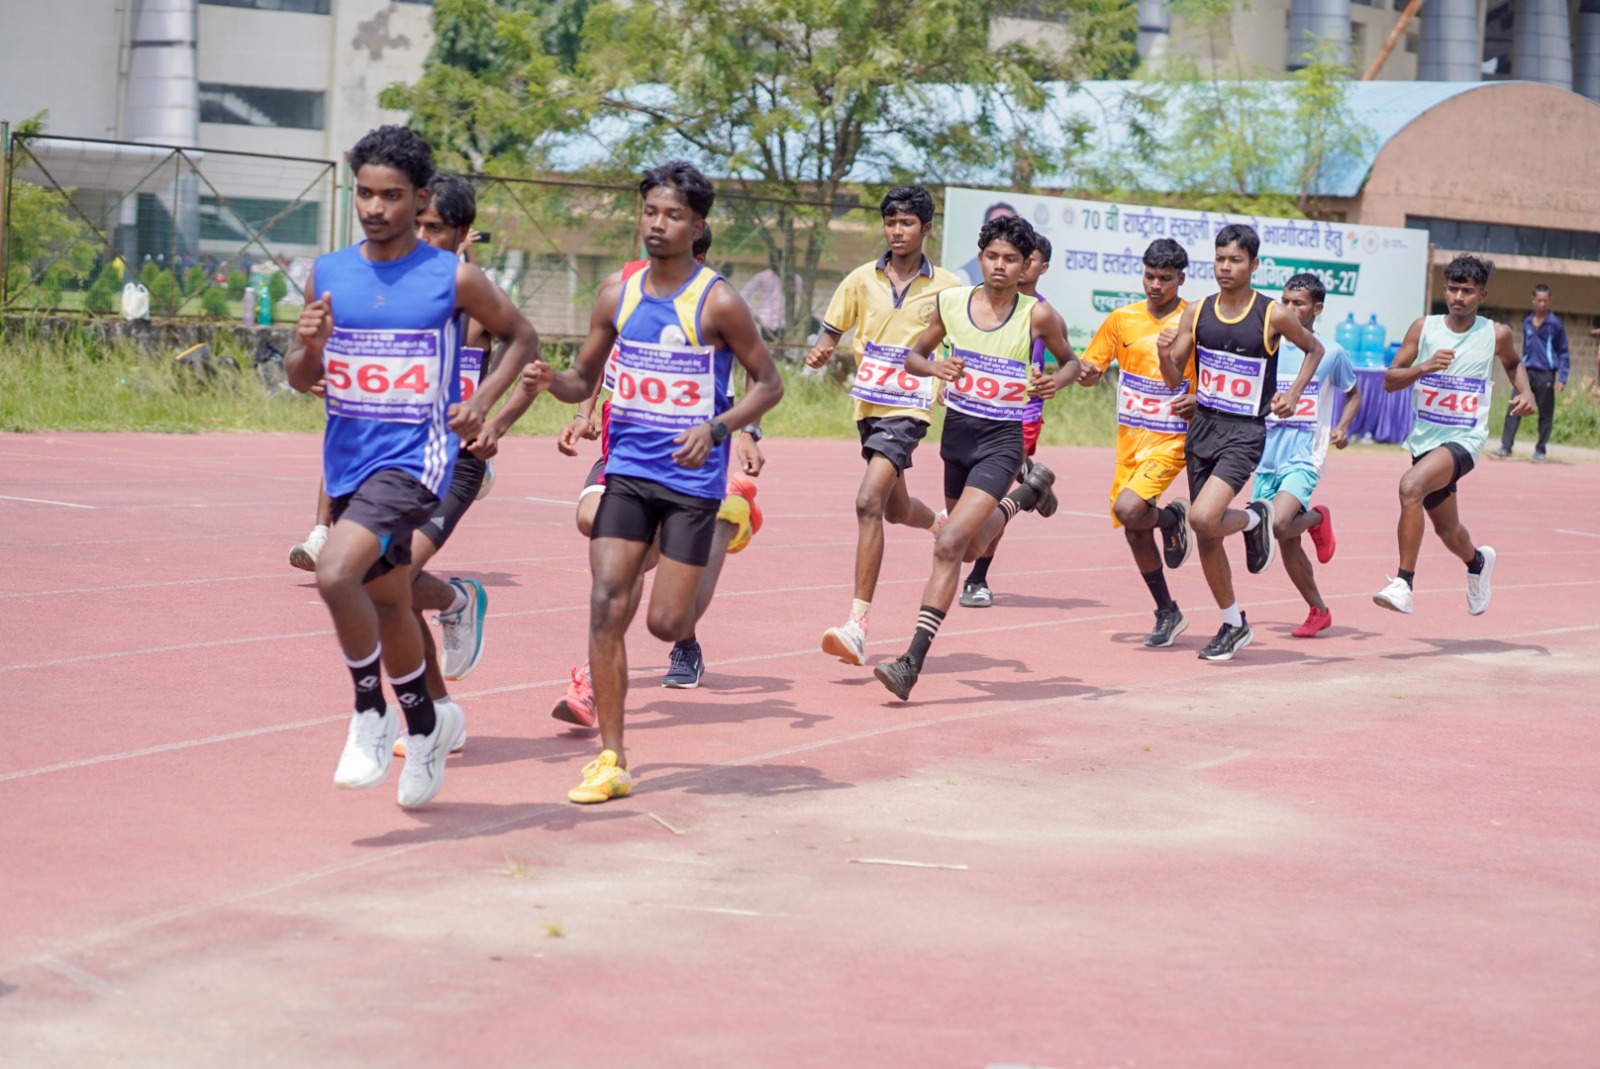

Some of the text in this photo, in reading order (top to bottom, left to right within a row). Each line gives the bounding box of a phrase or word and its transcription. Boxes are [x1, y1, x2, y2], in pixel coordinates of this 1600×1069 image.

[1082, 208, 1101, 230] 70
[1123, 208, 1165, 238] राष्ट्रीय
[1169, 211, 1210, 246] स्कूली
[1263, 220, 1320, 248] भागीदारी
[1324, 222, 1344, 258] हेतु
[1065, 249, 1098, 272] राज्य
[327, 359, 430, 395] 564
[618, 372, 702, 407] 003
[857, 361, 921, 391] 576
[953, 370, 1027, 401] 092
[1200, 368, 1251, 398] 010
[1421, 388, 1479, 413] 740
